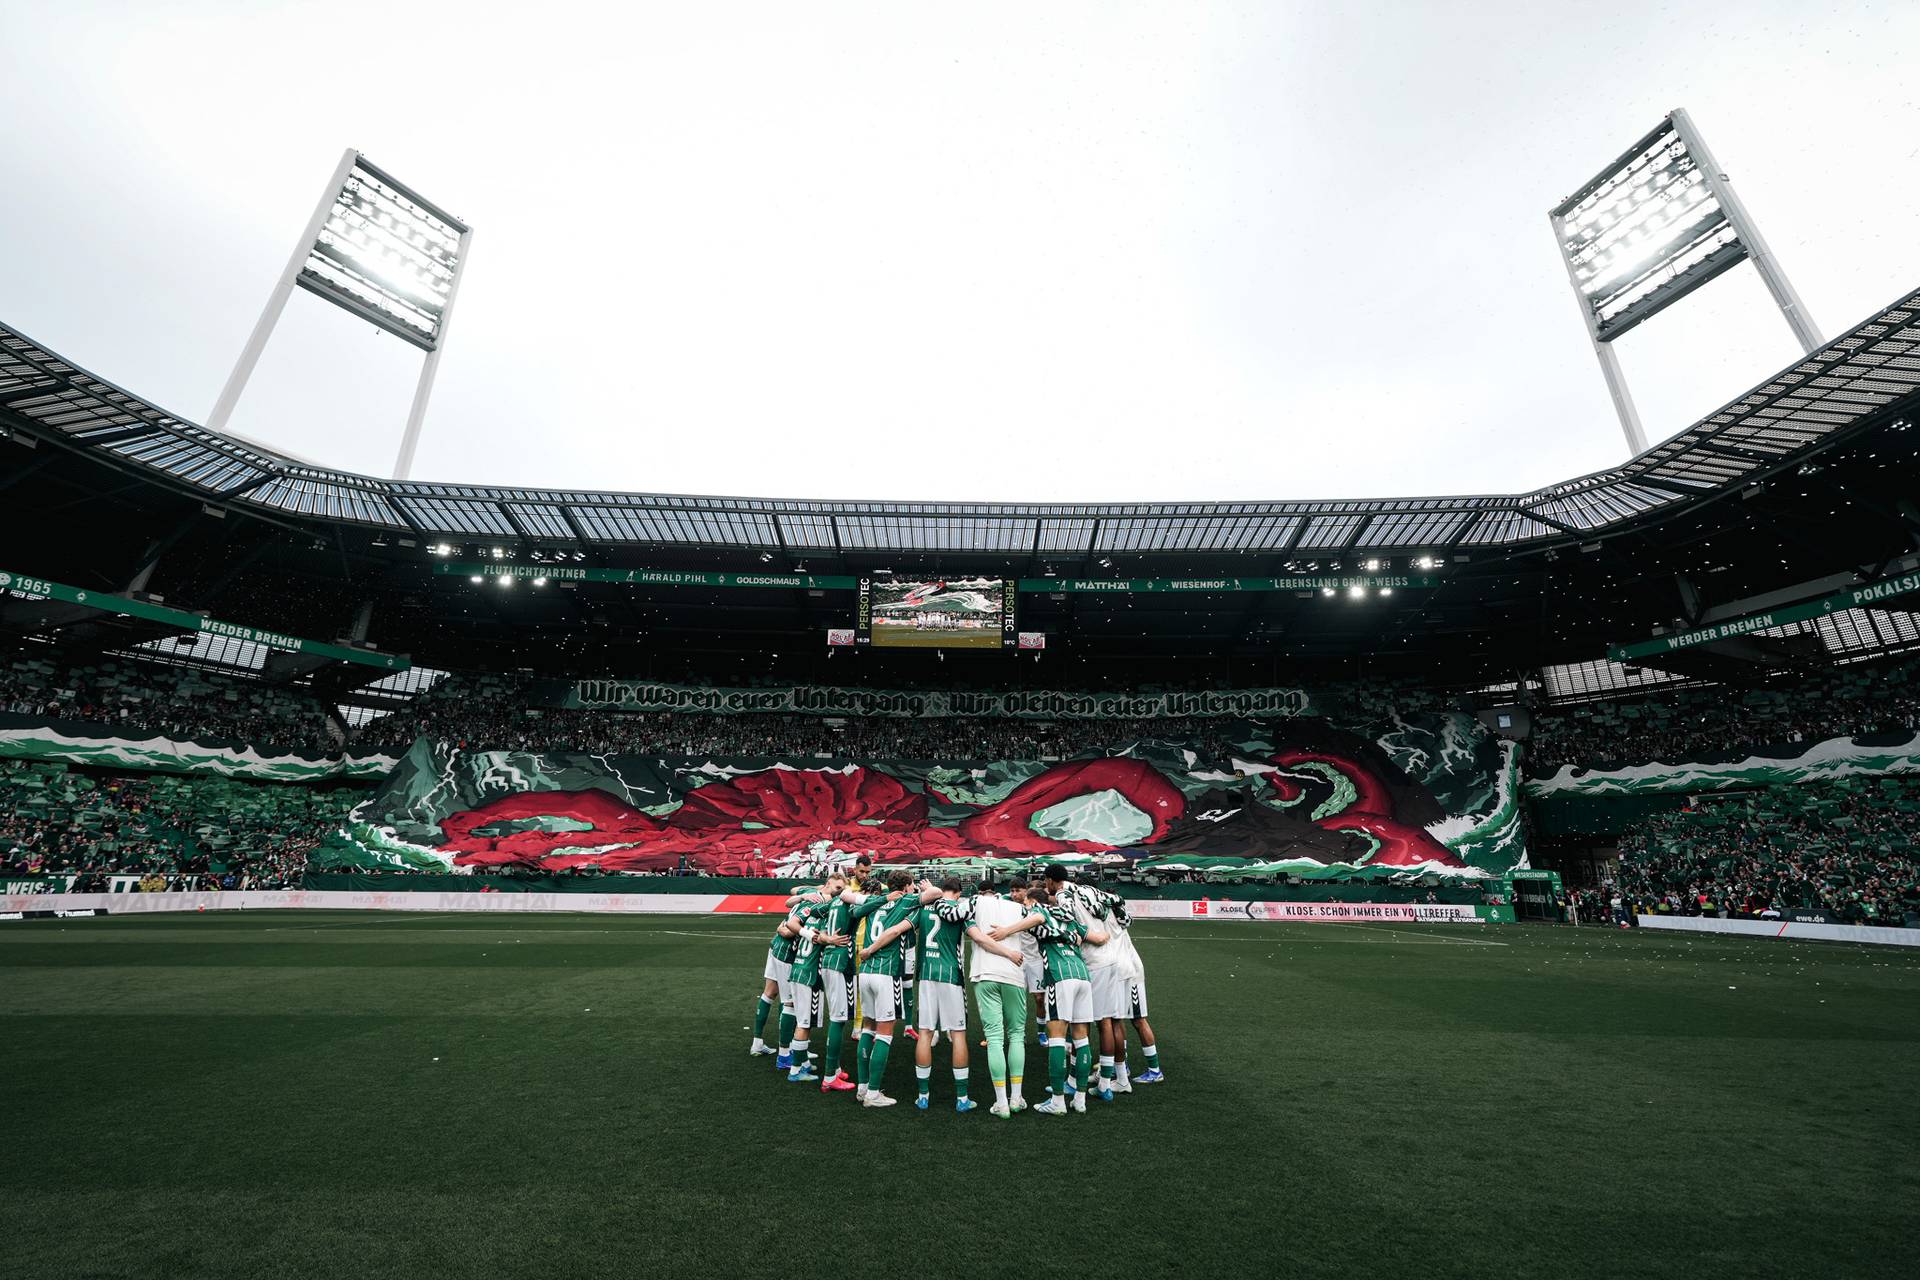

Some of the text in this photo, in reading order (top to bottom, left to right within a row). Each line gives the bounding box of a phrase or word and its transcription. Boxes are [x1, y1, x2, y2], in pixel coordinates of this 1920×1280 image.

[484, 565, 586, 579] FLUTLICHTPARTNER
[684, 574, 707, 583] PIHL
[736, 576, 800, 585] GOLDSCHMAUS
[16, 577, 52, 594] 1965
[1171, 581, 1225, 589] WIESENHOF
[1274, 578, 1338, 588] LEBENSLANG
[1852, 573, 1920, 603] POKALSI
[860, 578, 870, 630] PERSOTEC
[1005, 580, 1015, 632] PERSOTEC
[200, 619, 303, 650] WERDER BREMEN
[1667, 614, 1774, 649] WERDER BREMEN
[578, 680, 632, 704] Wir
[633, 684, 723, 708] waren
[726, 692, 790, 711] euer
[791, 686, 926, 717] Untergang
[949, 692, 1001, 716] Wir
[1099, 696, 1160, 717] euer
[1161, 690, 1308, 718] Untergang
[0, 881, 55, 895] -WEIS
[1286, 906, 1317, 916] KLOSE.
[1353, 907, 1382, 917] IMMER
[1384, 908, 1399, 917] EIN
[1796, 915, 1825, 923] ewe.de
[871, 909, 887, 942] 6
[926, 913, 942, 949] 2
